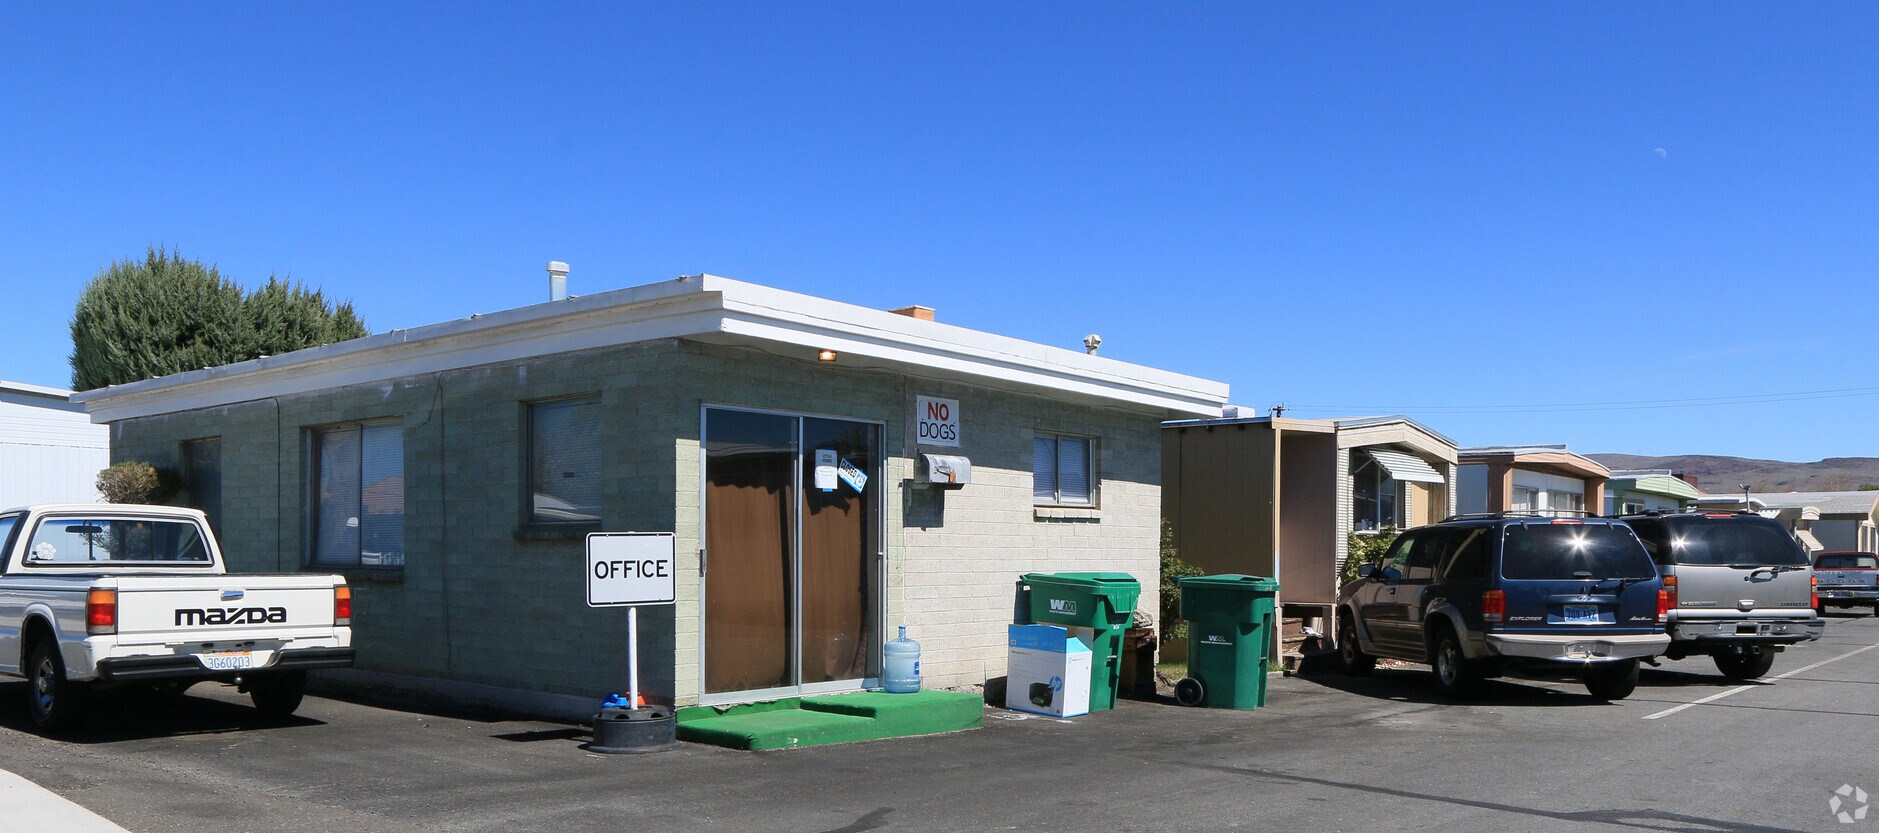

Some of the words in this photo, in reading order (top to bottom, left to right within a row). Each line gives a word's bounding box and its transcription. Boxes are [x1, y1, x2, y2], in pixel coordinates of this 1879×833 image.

[928, 401, 949, 421] NO
[920, 421, 956, 440] DOGS
[594, 559, 669, 580] OFFICE
[1049, 598, 1077, 613] WM
[1049, 676, 1063, 692] hp
